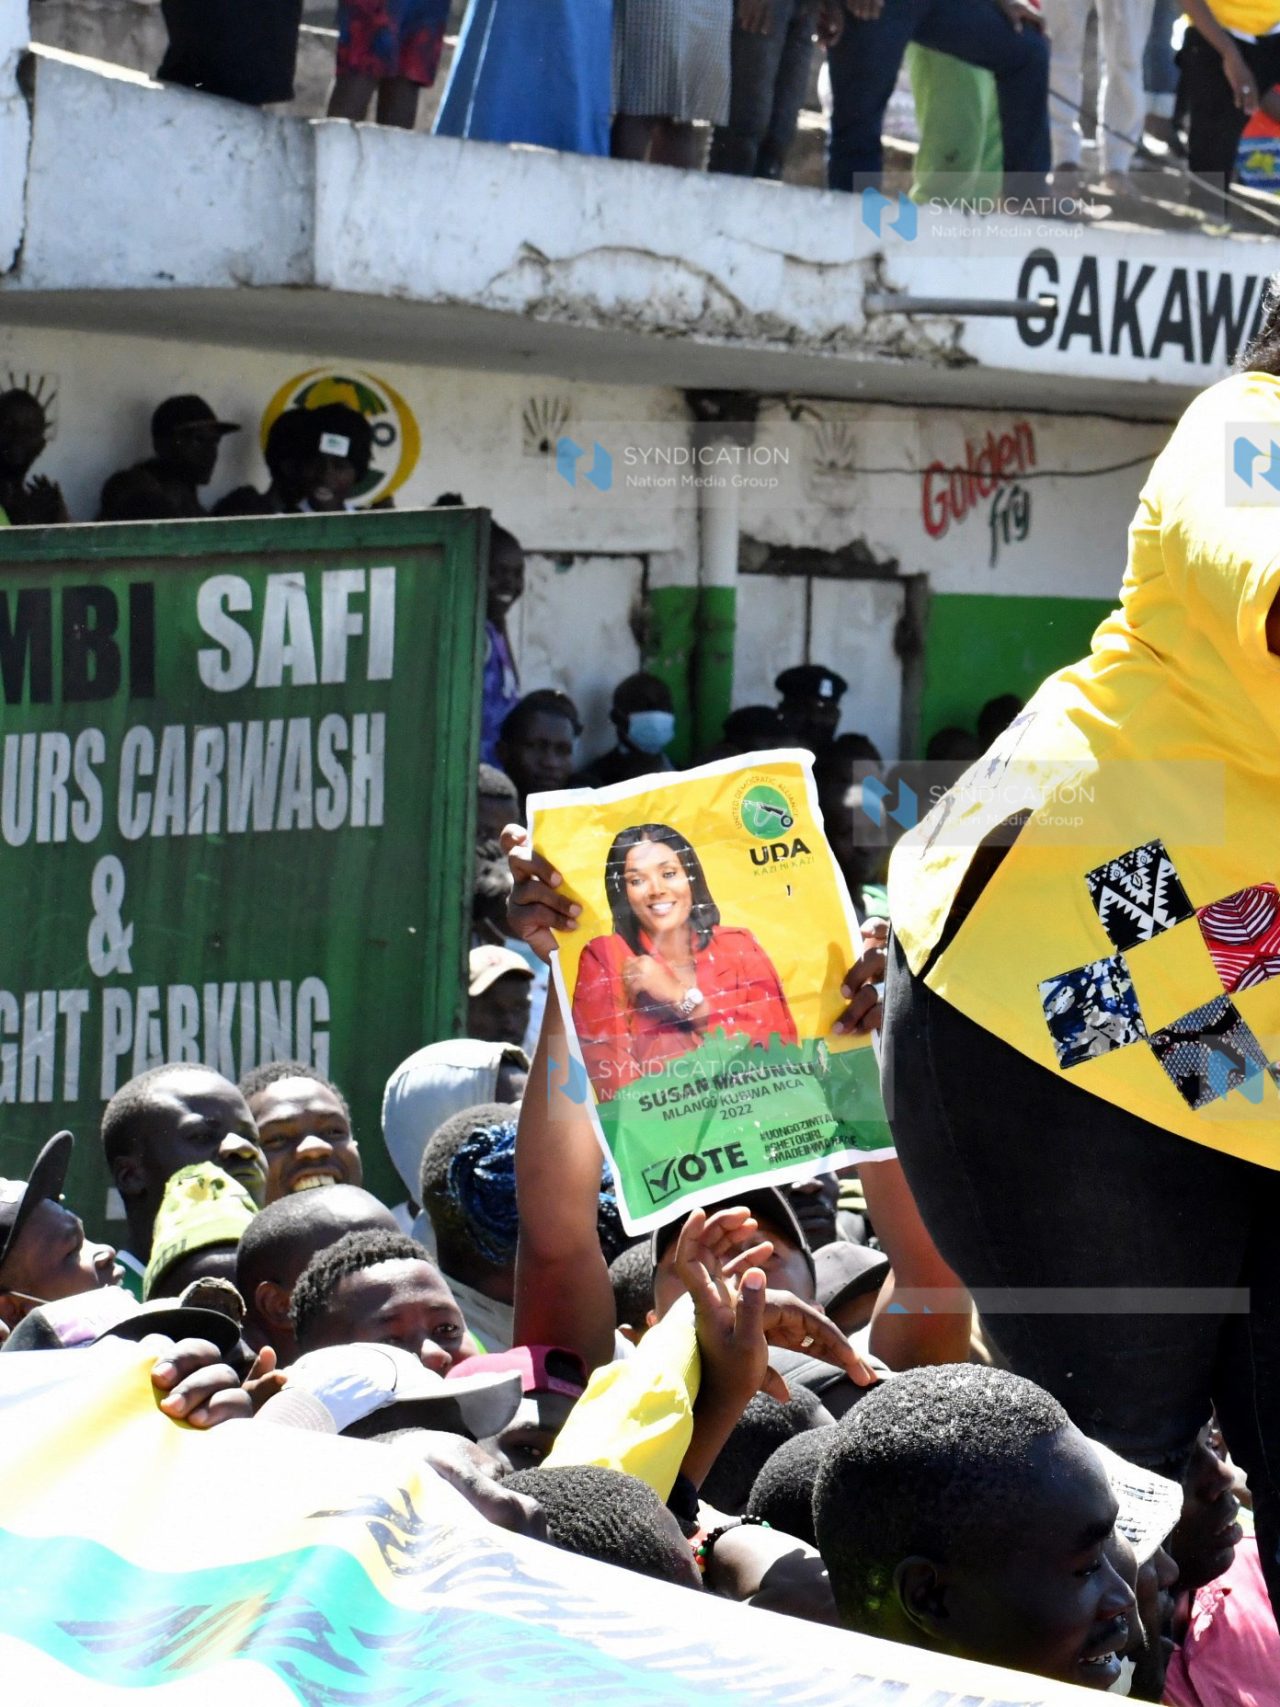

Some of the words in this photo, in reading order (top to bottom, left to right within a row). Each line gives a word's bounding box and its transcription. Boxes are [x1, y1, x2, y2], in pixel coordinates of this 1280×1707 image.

[922, 421, 1036, 541] Golden
[196, 567, 396, 692] SAFI
[118, 712, 386, 840] CARWASH
[749, 838, 812, 866] UDA
[87, 854, 134, 976] &
[101, 976, 331, 1100] PARKING
[639, 1077, 709, 1112] SUSAN
[662, 1096, 717, 1121] MLANGO
[773, 1078, 804, 1092] MCA
[720, 1103, 754, 1121] 2022
